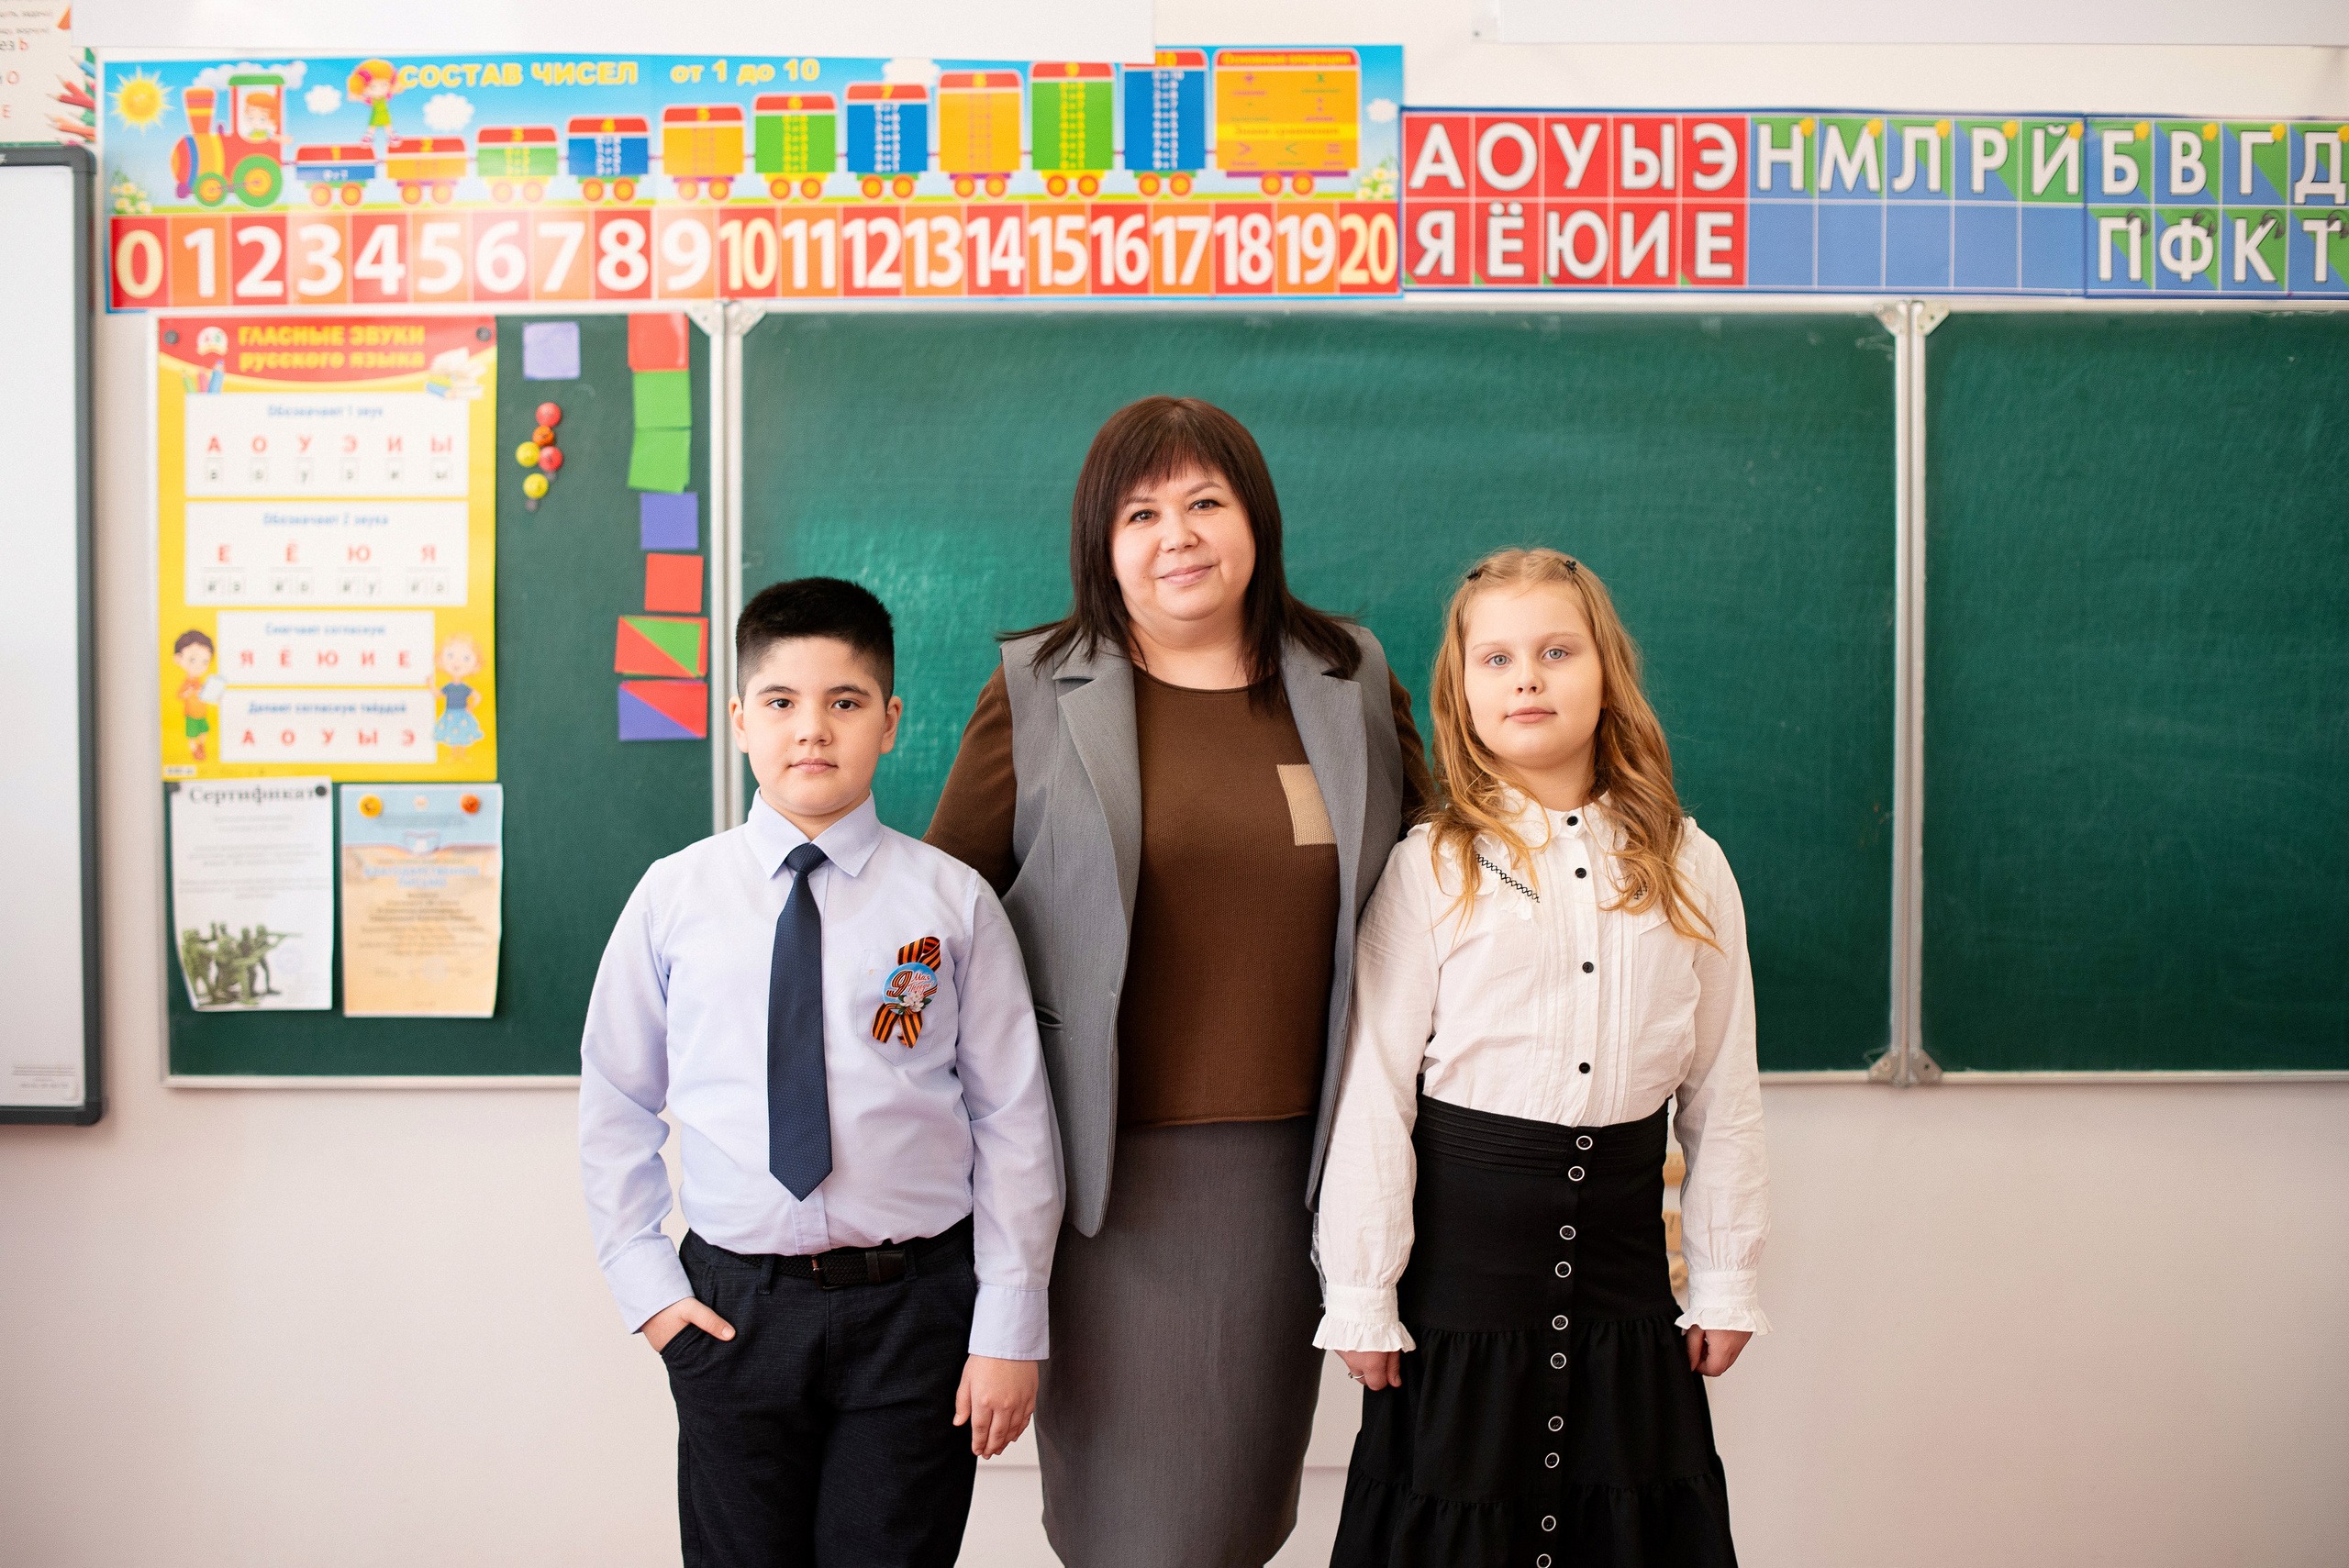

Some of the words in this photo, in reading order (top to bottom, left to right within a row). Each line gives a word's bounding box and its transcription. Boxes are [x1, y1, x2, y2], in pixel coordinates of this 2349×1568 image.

[399, 63, 523, 87] СОСТАВ
[532, 61, 639, 84] ЧИСЕЛ
[671, 65, 704, 83] от
[713, 60, 727, 82] 1
[738, 64, 774, 84] до
[785, 59, 820, 81] 10
[1408, 122, 1466, 189] А
[1476, 121, 1538, 191] О
[1551, 123, 1602, 189] У
[1620, 123, 1675, 190] Ы
[1693, 123, 1738, 191] Э
[1757, 123, 1805, 192] Н
[1819, 124, 1881, 192] М
[1892, 126, 1942, 193] Л
[1970, 127, 2008, 194] Р
[2032, 124, 2079, 196] Й
[2102, 129, 2139, 195] Б
[2170, 130, 2207, 195] В
[2240, 131, 2275, 195] Г
[2294, 132, 2347, 205] Д
[1413, 209, 1455, 277] Я
[1486, 201, 1525, 277] Ё
[1546, 209, 1609, 279] Ю
[1620, 210, 1670, 279] И
[1696, 212, 1733, 278] Е
[2099, 217, 2142, 282] П
[2159, 217, 2213, 282] Ф
[2233, 218, 2277, 284] К
[2303, 218, 2342, 283] Т
[116, 228, 163, 298] 0
[184, 228, 216, 297] 1
[236, 226, 284, 297] 2
[296, 224, 343, 295] 3
[353, 224, 406, 295] 4
[417, 223, 462, 295] 5
[474, 220, 527, 293] 6
[537, 220, 585, 292] 7
[596, 217, 649, 291] 8
[661, 217, 711, 290] 9
[718, 217, 779, 289] 10
[781, 218, 836, 289] 11
[842, 217, 901, 288] 12
[904, 217, 964, 286] 13
[967, 217, 1026, 286] 14
[1028, 215, 1087, 286] 15
[1090, 215, 1150, 285] 16
[1152, 215, 1212, 285] 17
[1213, 213, 1274, 285] 18
[1276, 213, 1337, 284] 19
[1339, 213, 1397, 284] 20
[238, 326, 345, 346] ГЛАСНЫЕ
[350, 326, 425, 346] ЗВУКИ
[238, 351, 345, 373] русского
[350, 351, 425, 368] языка
[208, 436, 221, 452] А
[251, 436, 267, 452] О
[298, 436, 311, 452] У
[342, 436, 358, 452] Э
[387, 436, 402, 452] И
[431, 436, 452, 452] Ы
[217, 545, 230, 562] Е
[348, 545, 371, 562] Ю
[420, 544, 436, 562] Я
[240, 651, 254, 666] Я
[280, 647, 292, 666] Ё
[317, 651, 339, 666] Ю
[362, 651, 375, 666] И
[398, 651, 409, 666] Е
[242, 729, 255, 745] А
[281, 729, 295, 745] О
[322, 729, 335, 745] У
[358, 729, 377, 745] Ы
[402, 729, 415, 745] Э
[189, 784, 316, 805] Сертификат
[886, 970, 913, 997] 9
